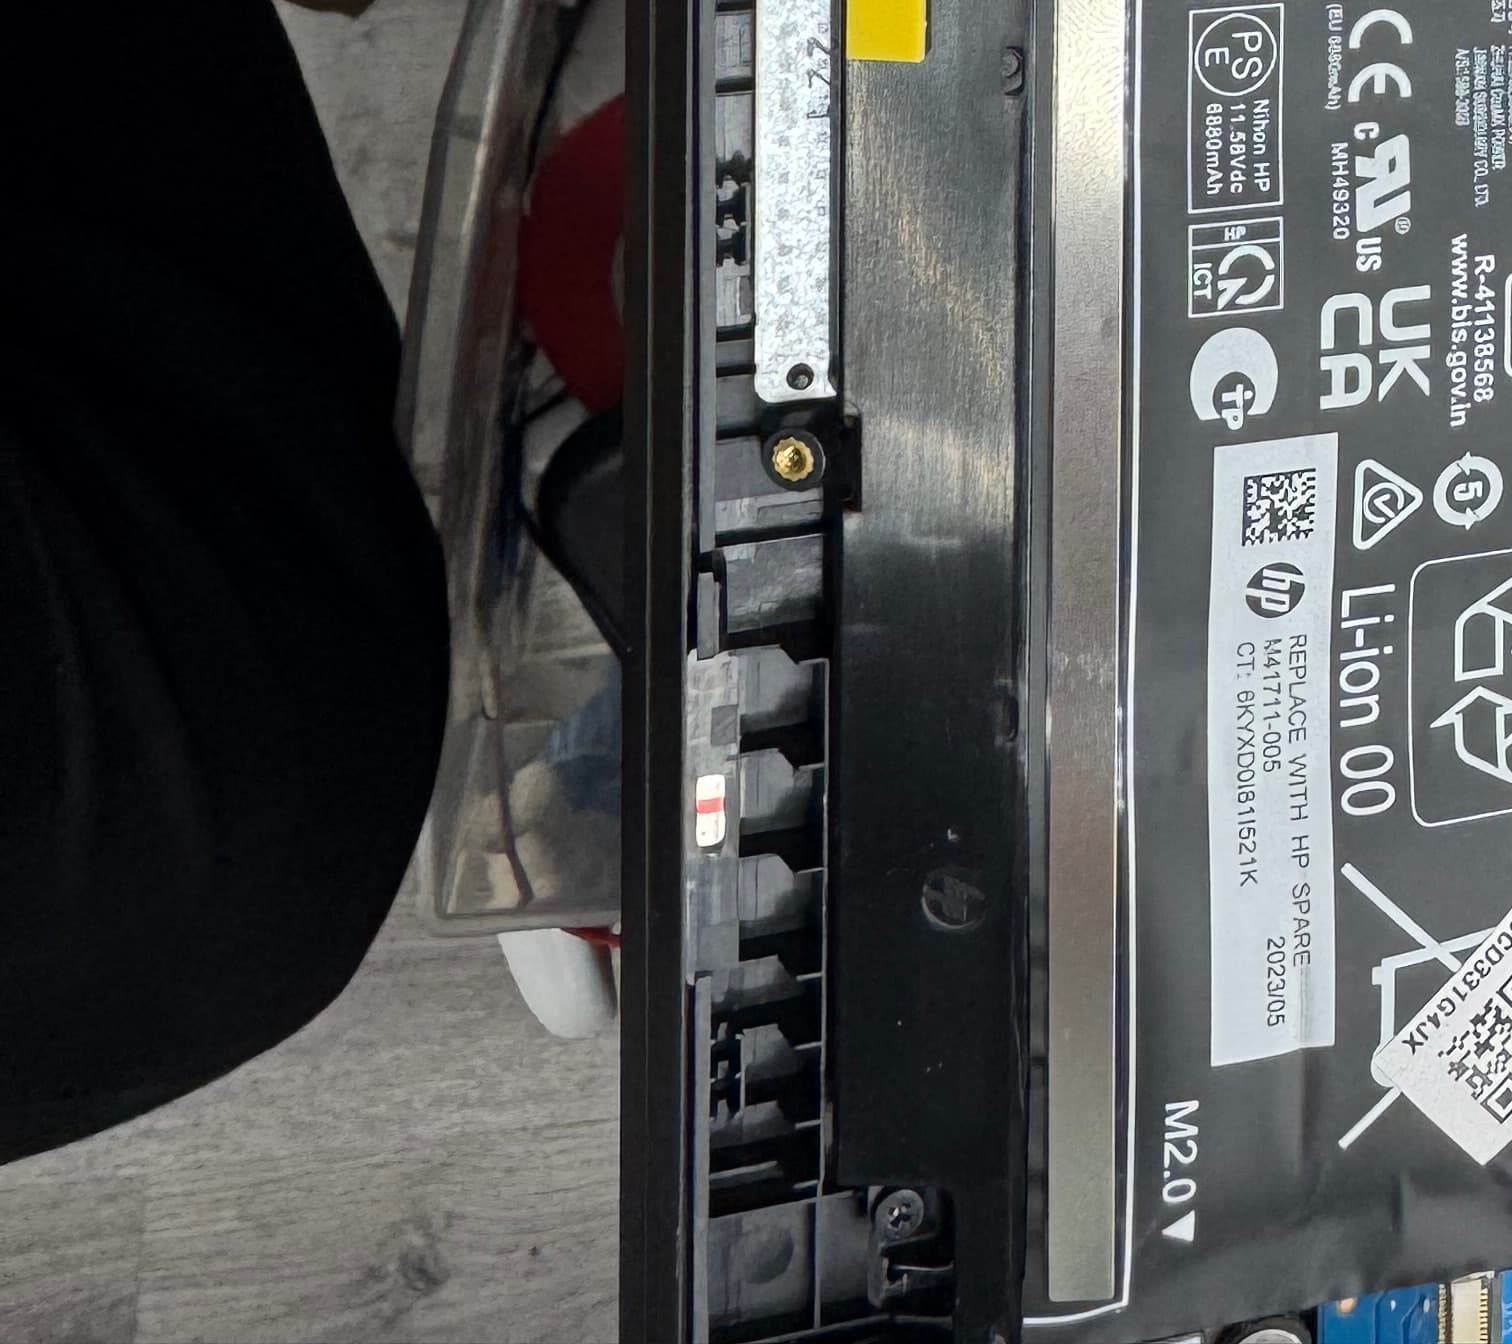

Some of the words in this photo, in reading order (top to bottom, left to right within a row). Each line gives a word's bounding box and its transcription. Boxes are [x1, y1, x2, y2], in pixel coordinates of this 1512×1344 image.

[1347, 8, 1413, 103] CE
[1253, 99, 1270, 154] Nihon
[1253, 163, 1270, 191] HP
[1331, 142, 1350, 239] MH49320
[1191, 262, 1213, 301] ICT
[1356, 237, 1382, 272] US
[1319, 292, 1372, 410] CA
[1378, 285, 1431, 403] UK
[1446, 234, 1473, 427] www.bis.gov.in
[1473, 255, 1495, 402] R-41138568
[1455, 480, 1483, 501] 5
[1288, 633, 1307, 743] REPLACE
[1341, 584, 1395, 727] Li-ion
[1262, 638, 1281, 773] M41711-005
[1289, 753, 1308, 821] WITH
[1341, 745, 1395, 816] 00
[1291, 835, 1310, 869] HP
[1292, 883, 1311, 967] SPARE
[1266, 936, 1286, 1027] 2023/05
[1162, 1100, 1199, 1206] M2.0
